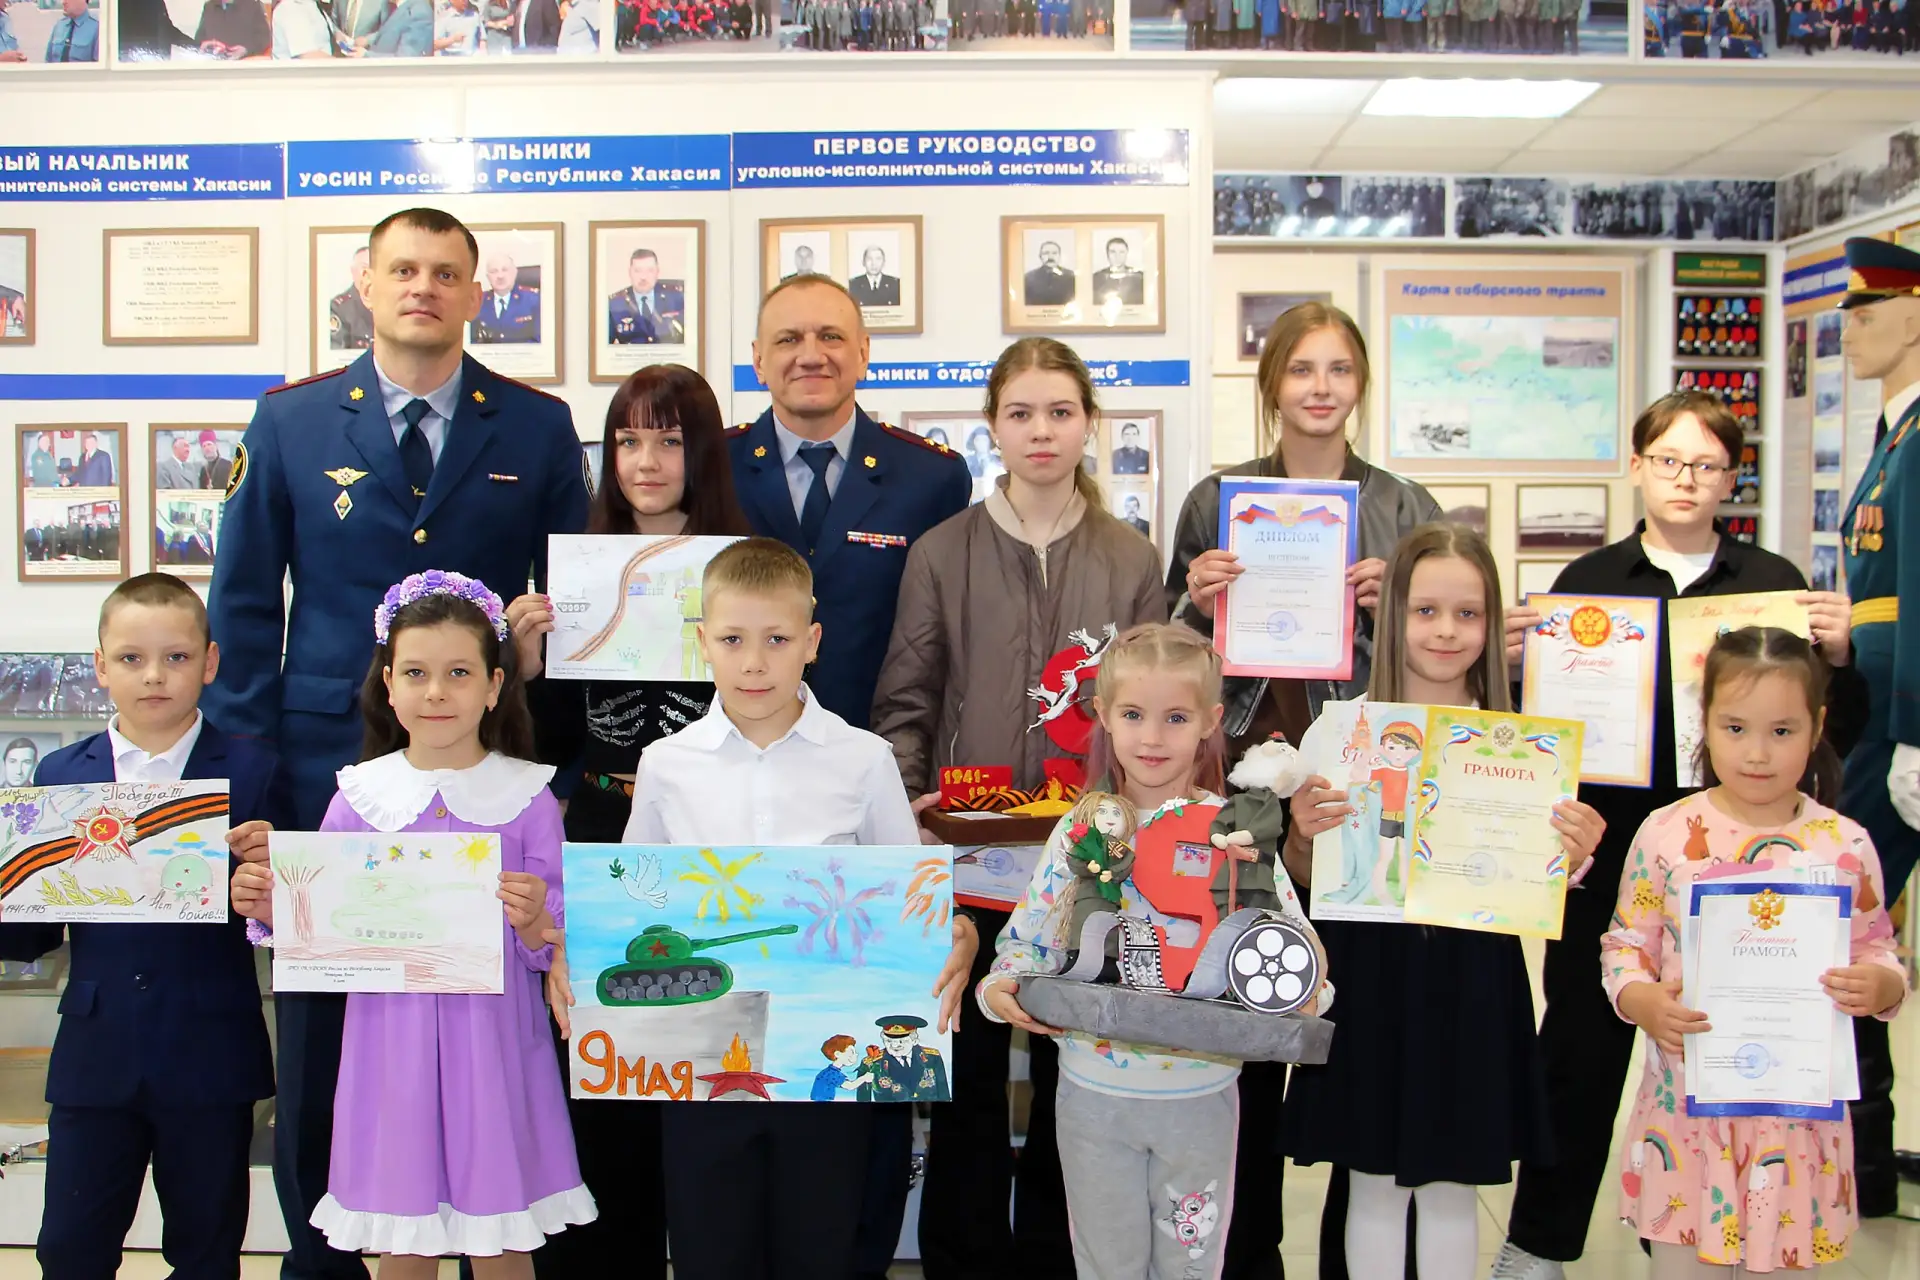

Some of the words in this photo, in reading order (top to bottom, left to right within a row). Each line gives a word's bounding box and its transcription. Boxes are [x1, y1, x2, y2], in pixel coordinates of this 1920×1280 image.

[470, 141, 592, 161] АЛЬНИКИ
[813, 136, 909, 156] ПЕРВОЕ
[918, 136, 1097, 155] РУКОВОДСТВО
[0, 152, 40, 171] ЫЙ
[49, 153, 190, 171] НАЧАЛЬНИК
[737, 160, 993, 182] уголовно-исполнительной
[998, 162, 1085, 176] системы
[107, 178, 188, 192] системы
[193, 176, 272, 192] Хакасии
[299, 170, 373, 187] УФСИН
[380, 169, 450, 186] Росси
[496, 166, 624, 186] Республике
[630, 165, 721, 182] Хакасия
[1402, 283, 1450, 297] Карта
[1455, 283, 1542, 297] сибирского
[1546, 285, 1606, 299] тракта
[1254, 530, 1321, 544] ДИПЛОМ
[944, 768, 990, 785] 1941-
[1463, 762, 1536, 782] ГРАМОТА
[1732, 945, 1798, 958] ГРАМОТА
[577, 1029, 616, 1095] 9
[617, 1055, 694, 1101] МАЯ
